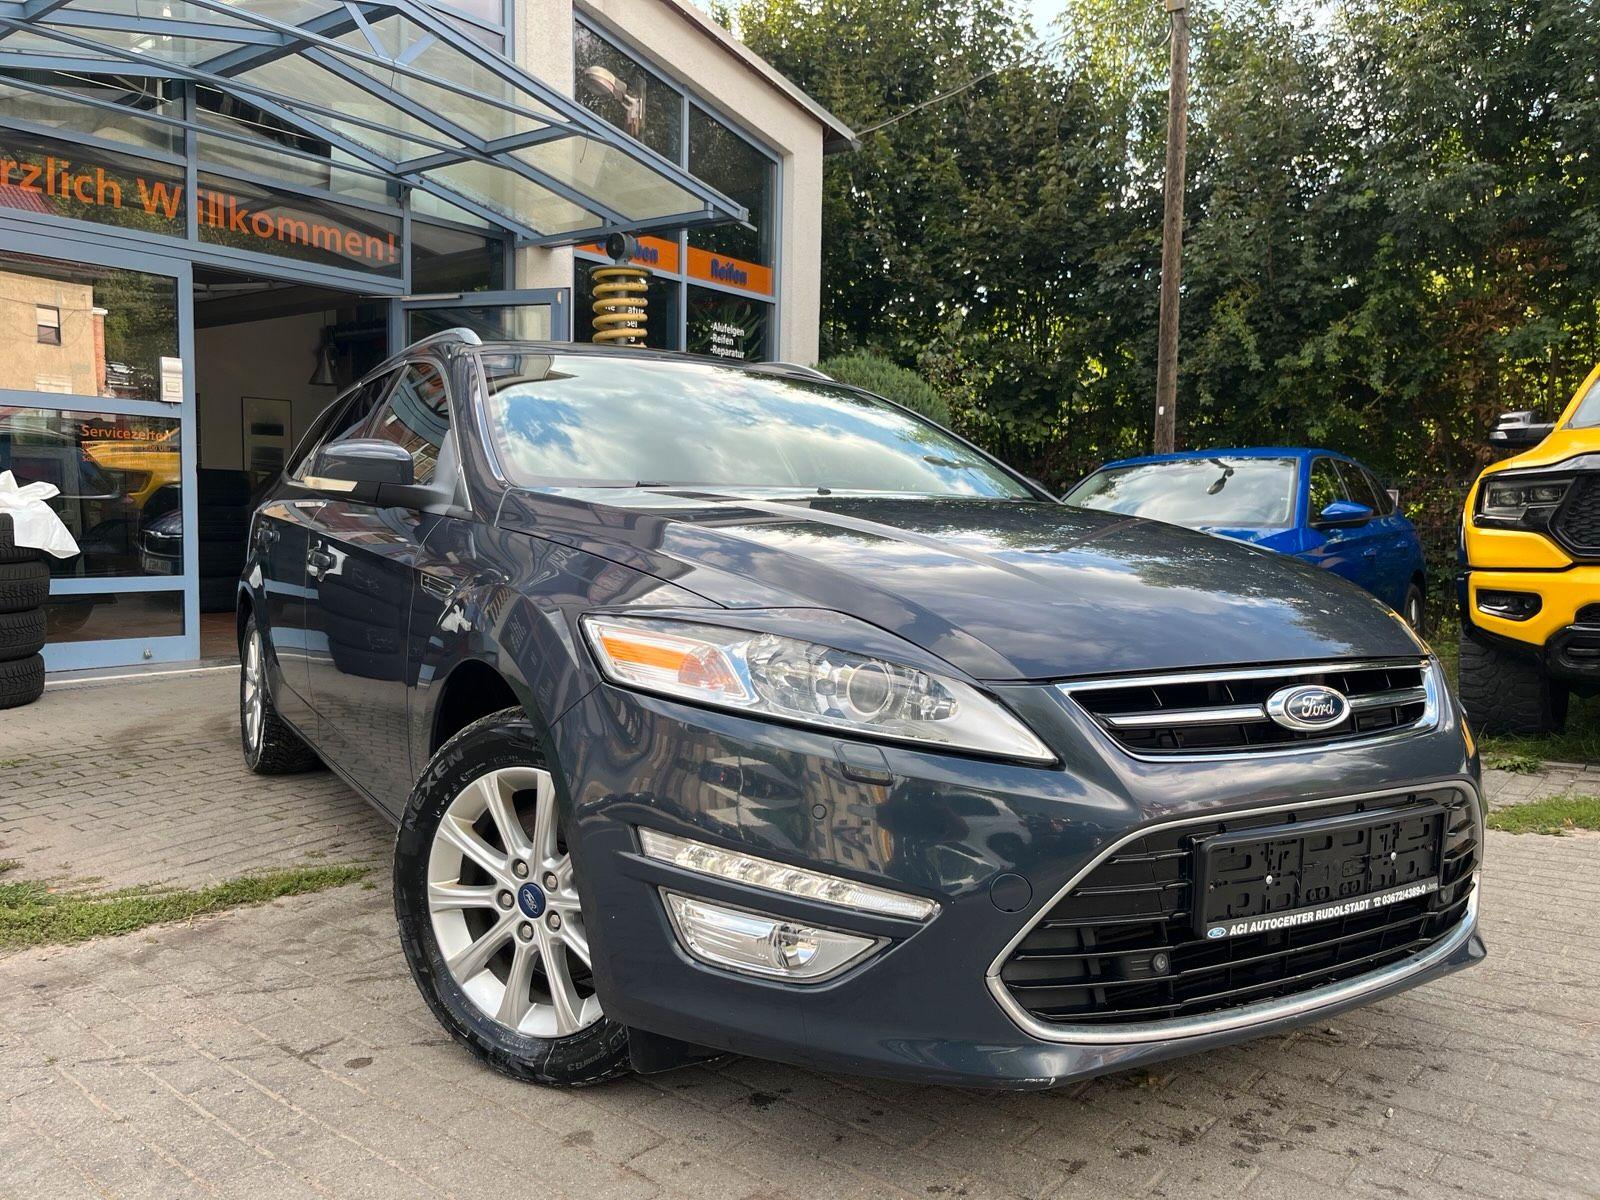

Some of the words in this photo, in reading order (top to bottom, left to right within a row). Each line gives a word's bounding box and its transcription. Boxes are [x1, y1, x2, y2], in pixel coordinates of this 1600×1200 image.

[711, 258, 747, 285] Reifen
[1301, 694, 1335, 717] Ford
[405, 741, 465, 832] NEXEN
[1229, 923, 1248, 936] ACI
[1250, 911, 1314, 933] AUTOCENTER
[1315, 899, 1371, 921] RUDOLSTADT
